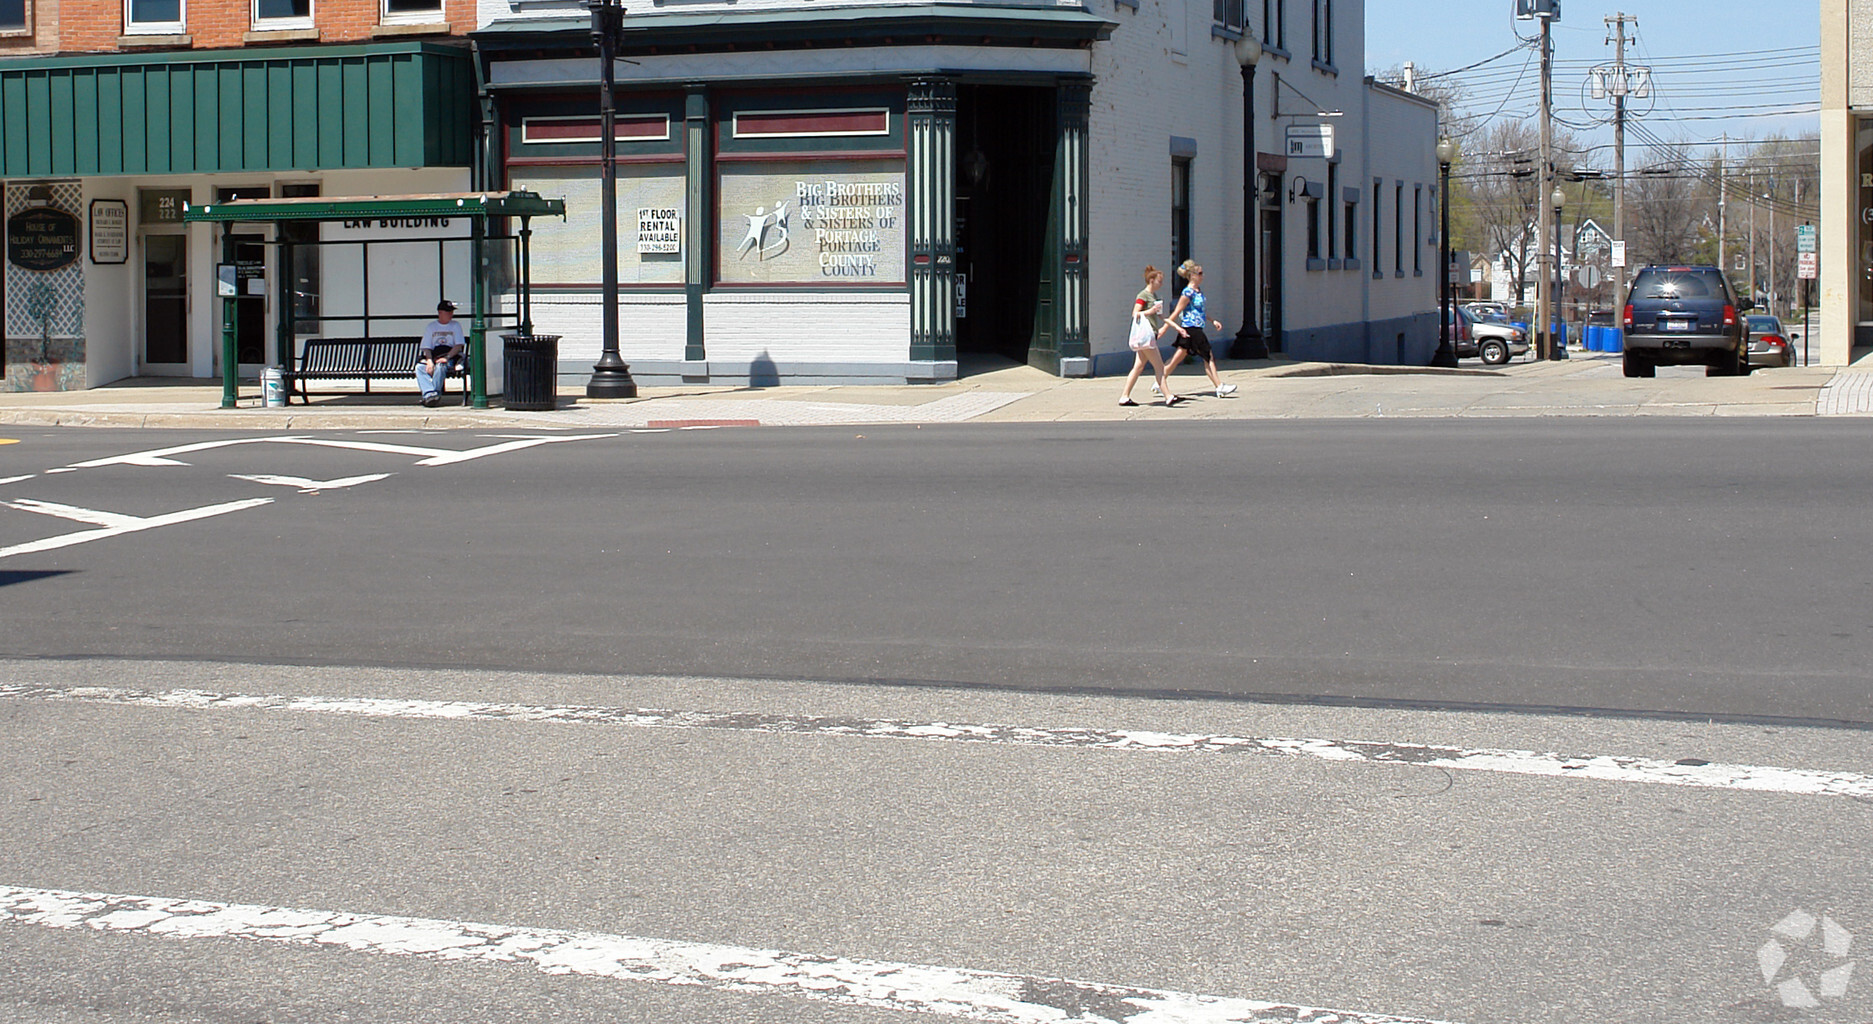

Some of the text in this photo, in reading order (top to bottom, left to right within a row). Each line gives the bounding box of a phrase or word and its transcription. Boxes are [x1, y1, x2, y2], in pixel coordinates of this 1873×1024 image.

[795, 180, 900, 197] BIG BROTHERS
[159, 197, 175, 208] 224
[159, 208, 176, 220] 222
[651, 209, 678, 220] FLOOR
[800, 204, 895, 220] & SISTERS OF
[25, 221, 46, 232] HOUSE
[344, 217, 450, 228] LAW BUILDING
[640, 221, 675, 232] RENTAL
[9, 234, 74, 245] HOLIDAY ORNAMENTS
[638, 232, 679, 242] AVAILABLE
[815, 228, 879, 245] PORTAGE
[63, 244, 75, 253] LLC
[819, 251, 875, 268] COUNTY
